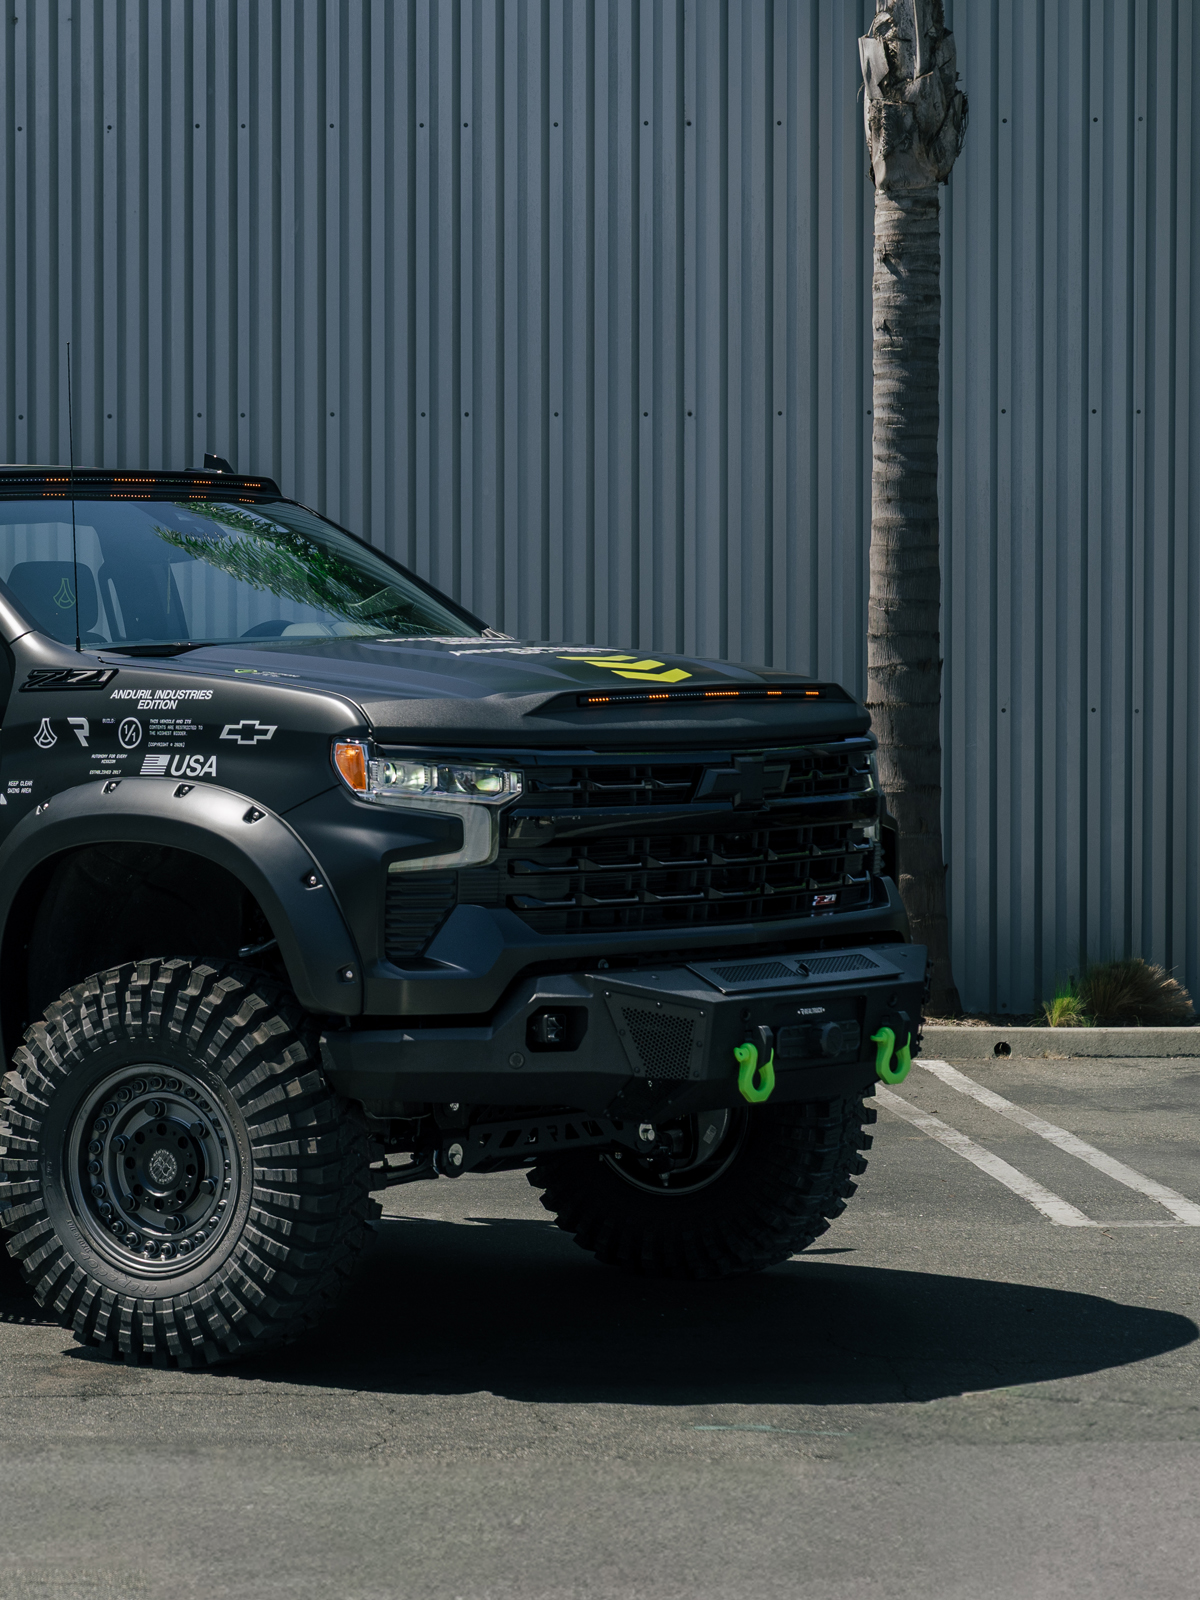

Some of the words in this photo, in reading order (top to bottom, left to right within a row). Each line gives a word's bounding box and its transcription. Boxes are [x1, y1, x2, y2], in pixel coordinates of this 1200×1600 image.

[18, 669, 119, 692] Z71
[110, 690, 152, 699] ANDURIL
[154, 690, 214, 700] INDUSTRIES
[137, 700, 178, 710] EDITION
[170, 754, 217, 777] USA
